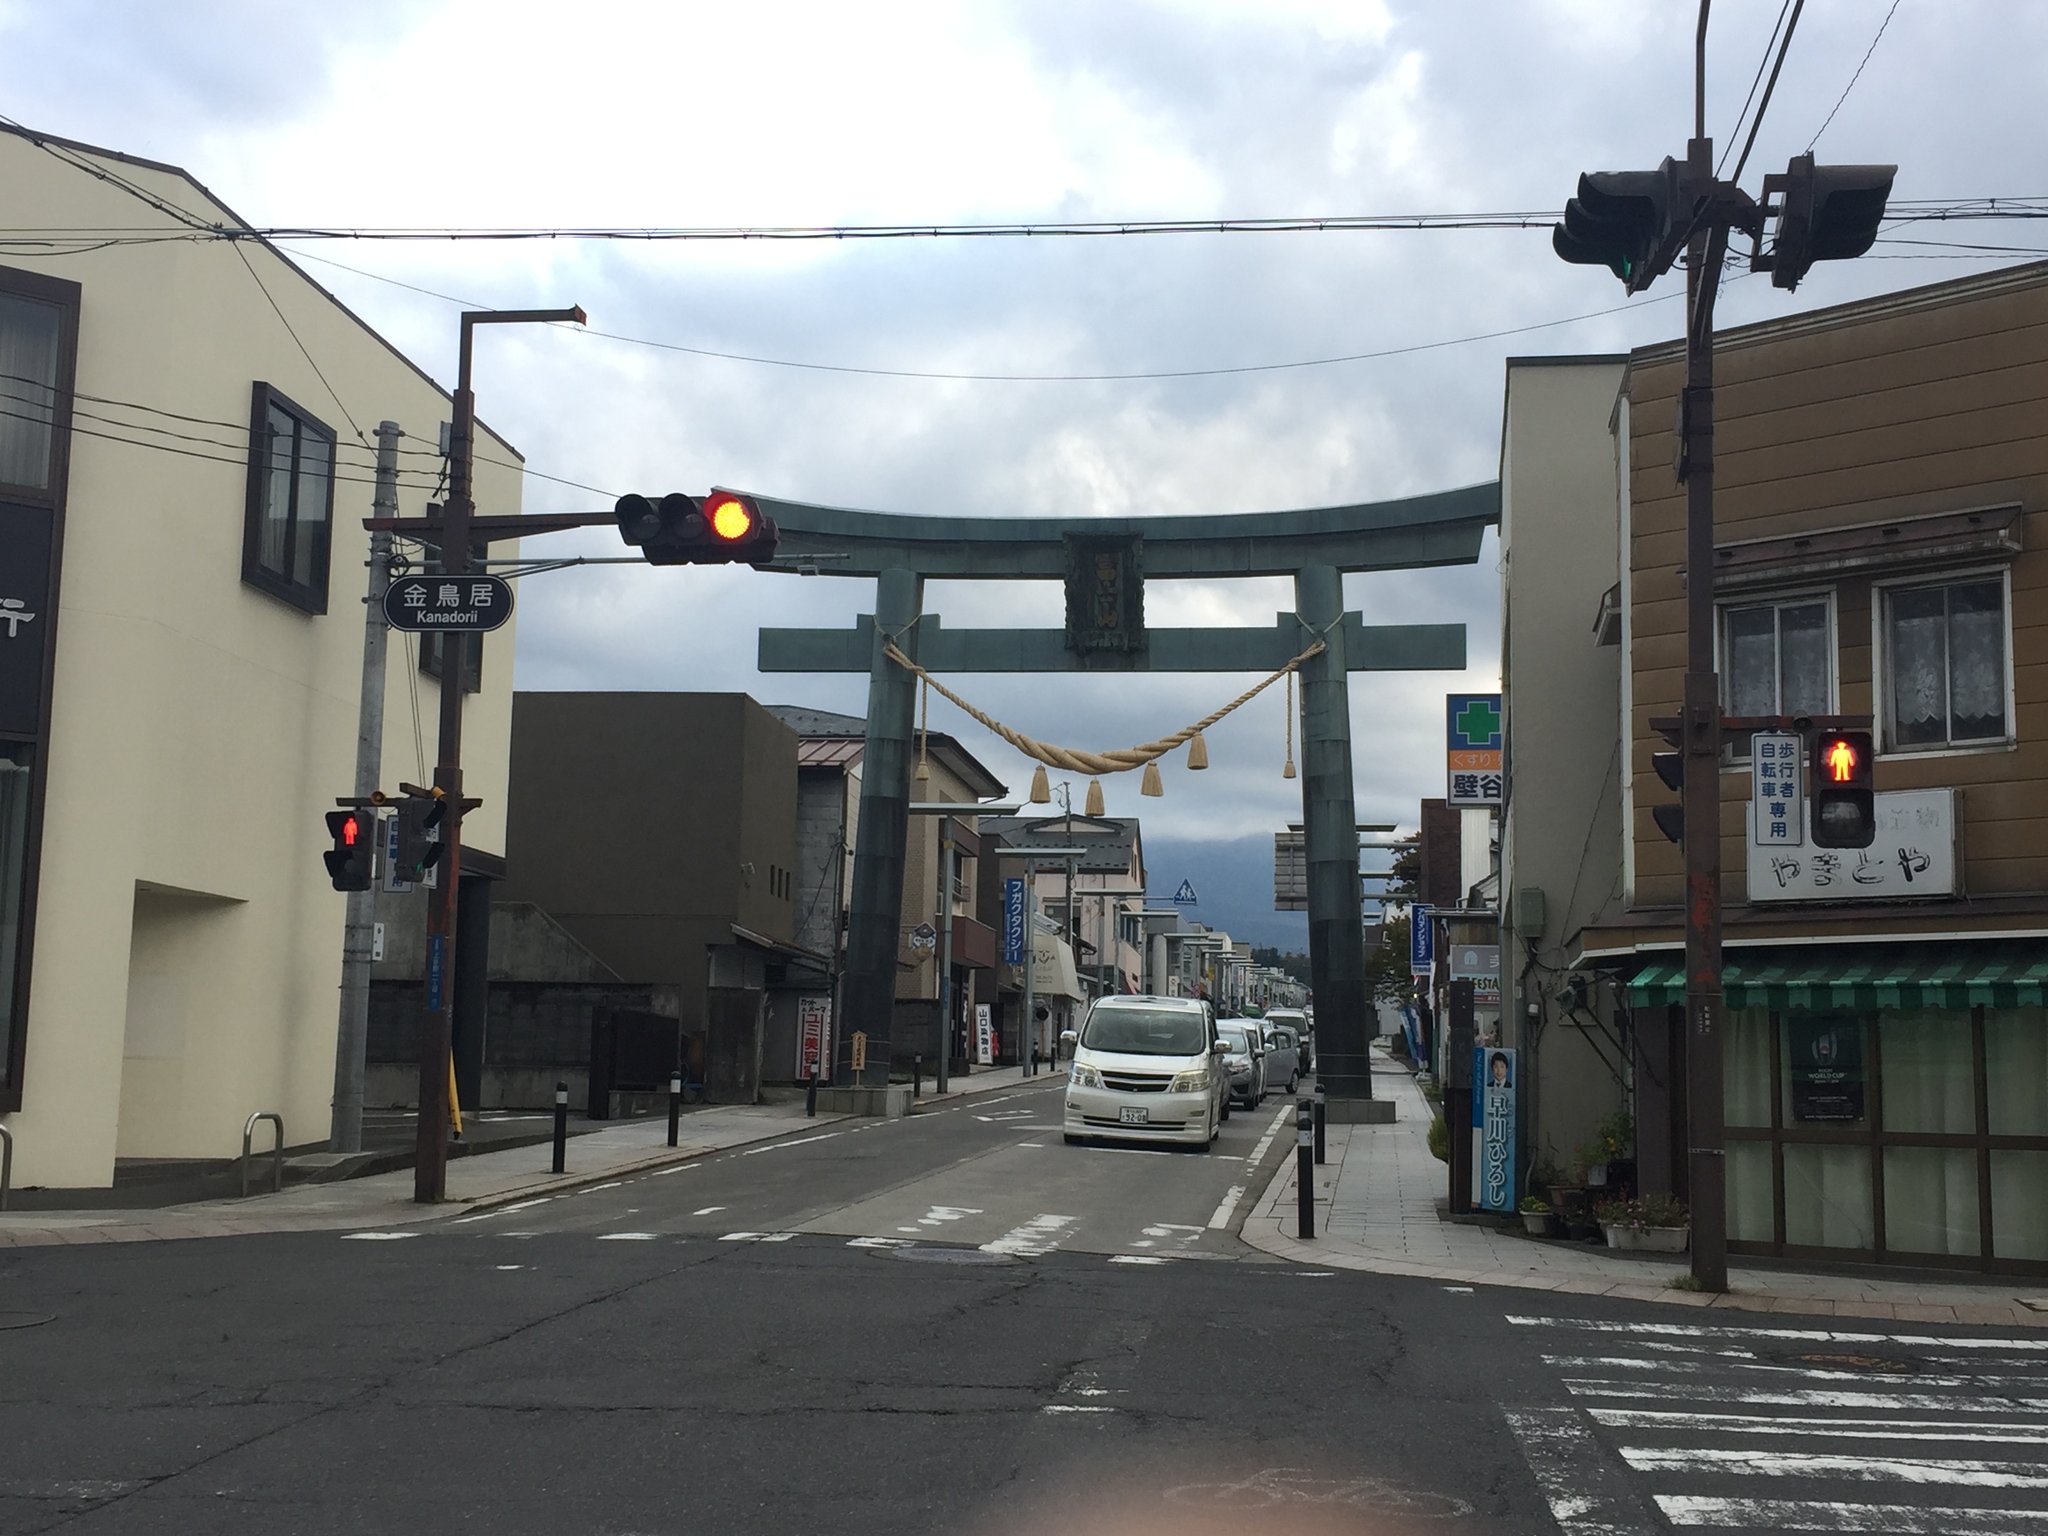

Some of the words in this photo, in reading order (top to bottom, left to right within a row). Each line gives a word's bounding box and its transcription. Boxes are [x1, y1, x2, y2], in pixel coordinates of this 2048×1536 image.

[403, 583, 494, 608] 金鳥居
[416, 610, 479, 624] Kanadorii
[1453, 773, 1502, 799] 壁谷
[1760, 742, 1777, 799] 自転車
[1778, 741, 1796, 799] 歩行者
[1768, 801, 1788, 839] 専用
[1769, 845, 1932, 889] やまとや
[1011, 881, 1022, 961] フガクタクシー
[1486, 1094, 1508, 1207] 早川ひろし
